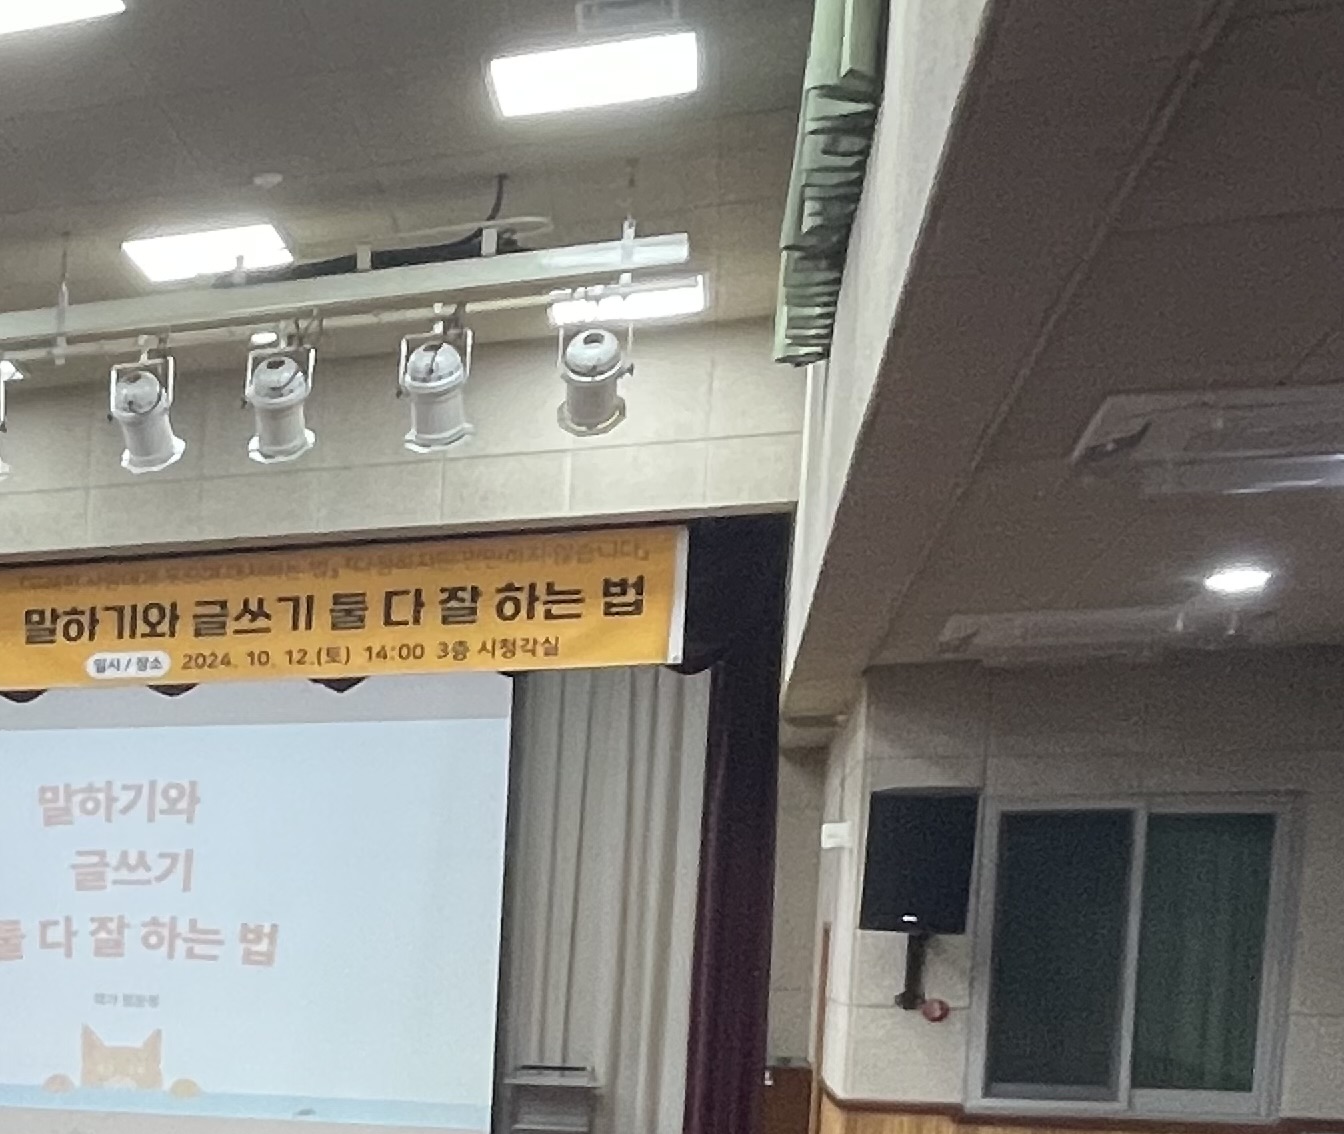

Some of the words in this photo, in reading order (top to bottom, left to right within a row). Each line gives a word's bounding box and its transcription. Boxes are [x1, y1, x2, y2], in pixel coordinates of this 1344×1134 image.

[24, 601, 180, 645] 말하기와
[192, 594, 315, 638] 글쓰기
[329, 591, 369, 631] 둘
[382, 587, 425, 627] 다
[438, 584, 484, 625] 잘
[494, 581, 586, 621] 하는
[602, 574, 645, 617] 법
[364, 642, 426, 662] 14:00
[436, 639, 470, 662] 3층
[477, 635, 561, 660] 시청각실
[37, 779, 201, 827] 말하기와
[69, 848, 194, 892] 글쓰기
[38, 915, 79, 959] 다
[89, 915, 131, 958] 잘
[140, 915, 225, 961] 하는
[238, 922, 279, 967] 법
